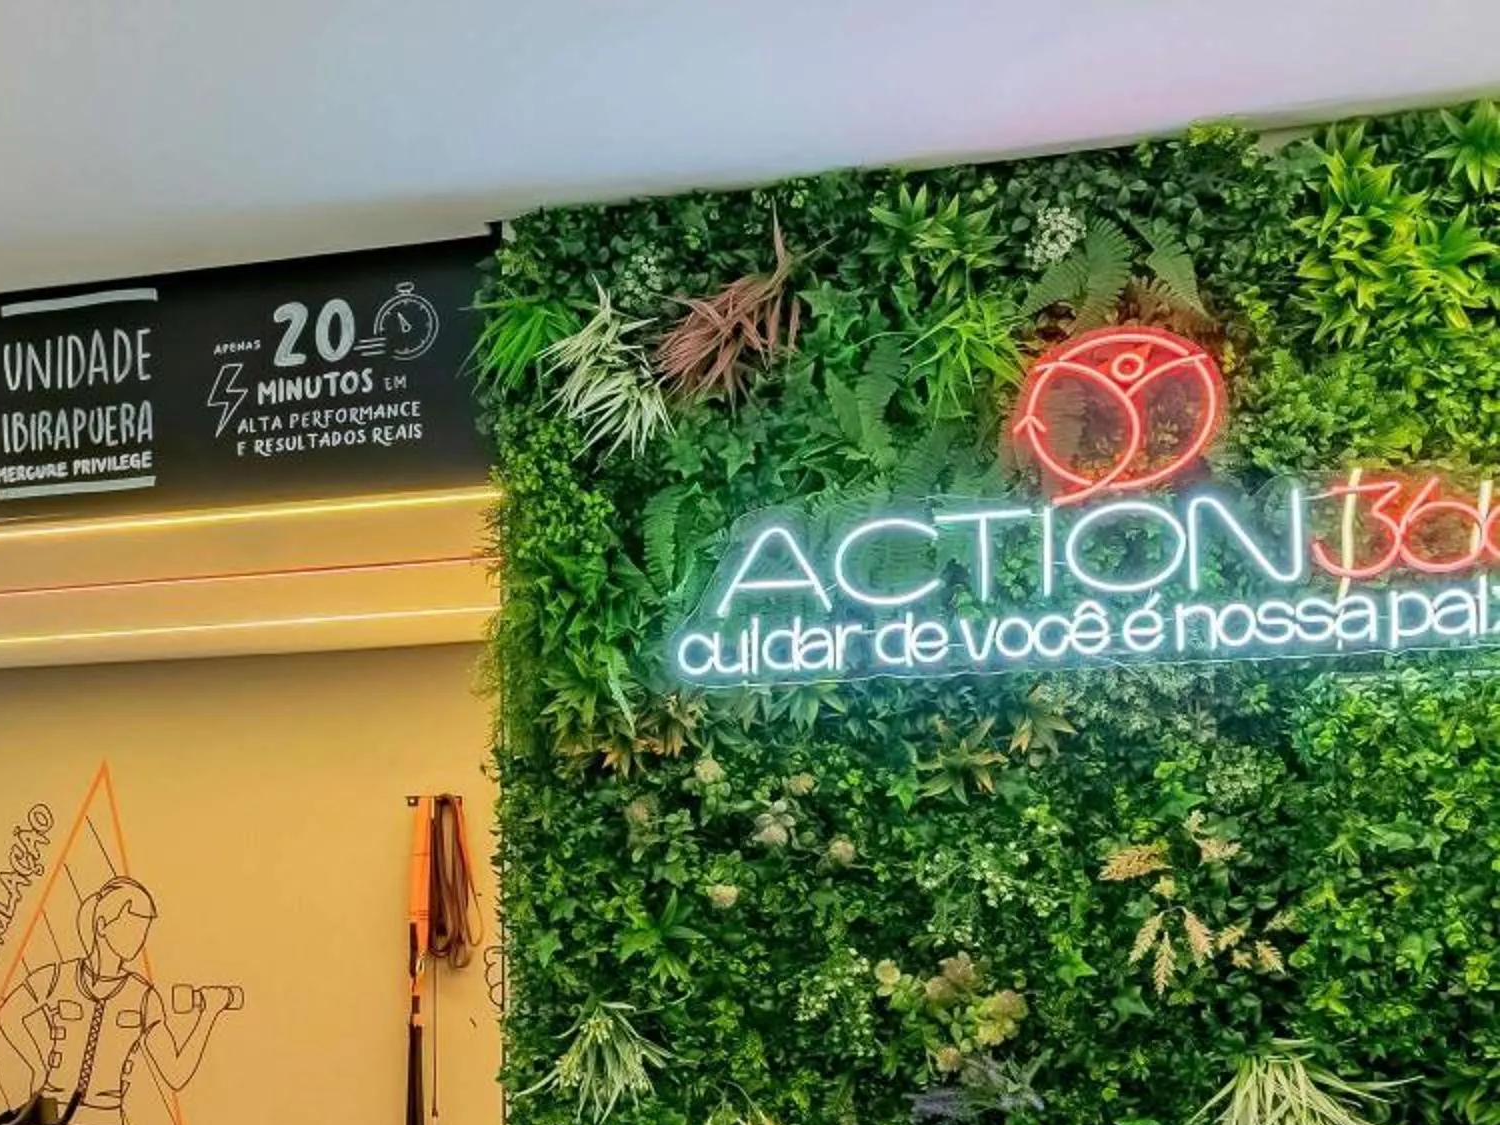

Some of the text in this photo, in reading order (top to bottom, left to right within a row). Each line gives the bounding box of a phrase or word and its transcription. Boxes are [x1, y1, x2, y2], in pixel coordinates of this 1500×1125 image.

[213, 297, 356, 368] APENAS 20
[2, 328, 153, 393] UNIDADE
[256, 367, 408, 406] MINUTOS EM
[1, 399, 154, 454] IBIRAPUERA
[236, 400, 422, 435] ALTA PERFORMANCE
[253, 429, 367, 457] RESULTADOS
[371, 423, 423, 447] REAIS
[73, 450, 154, 476] PRIVILEGE
[714, 472, 1500, 619] ACTION 36
[676, 613, 864, 677] cuidar
[873, 610, 951, 669] de
[958, 598, 1112, 662] você
[1121, 590, 1165, 652] é
[1173, 593, 1378, 650] nossa
